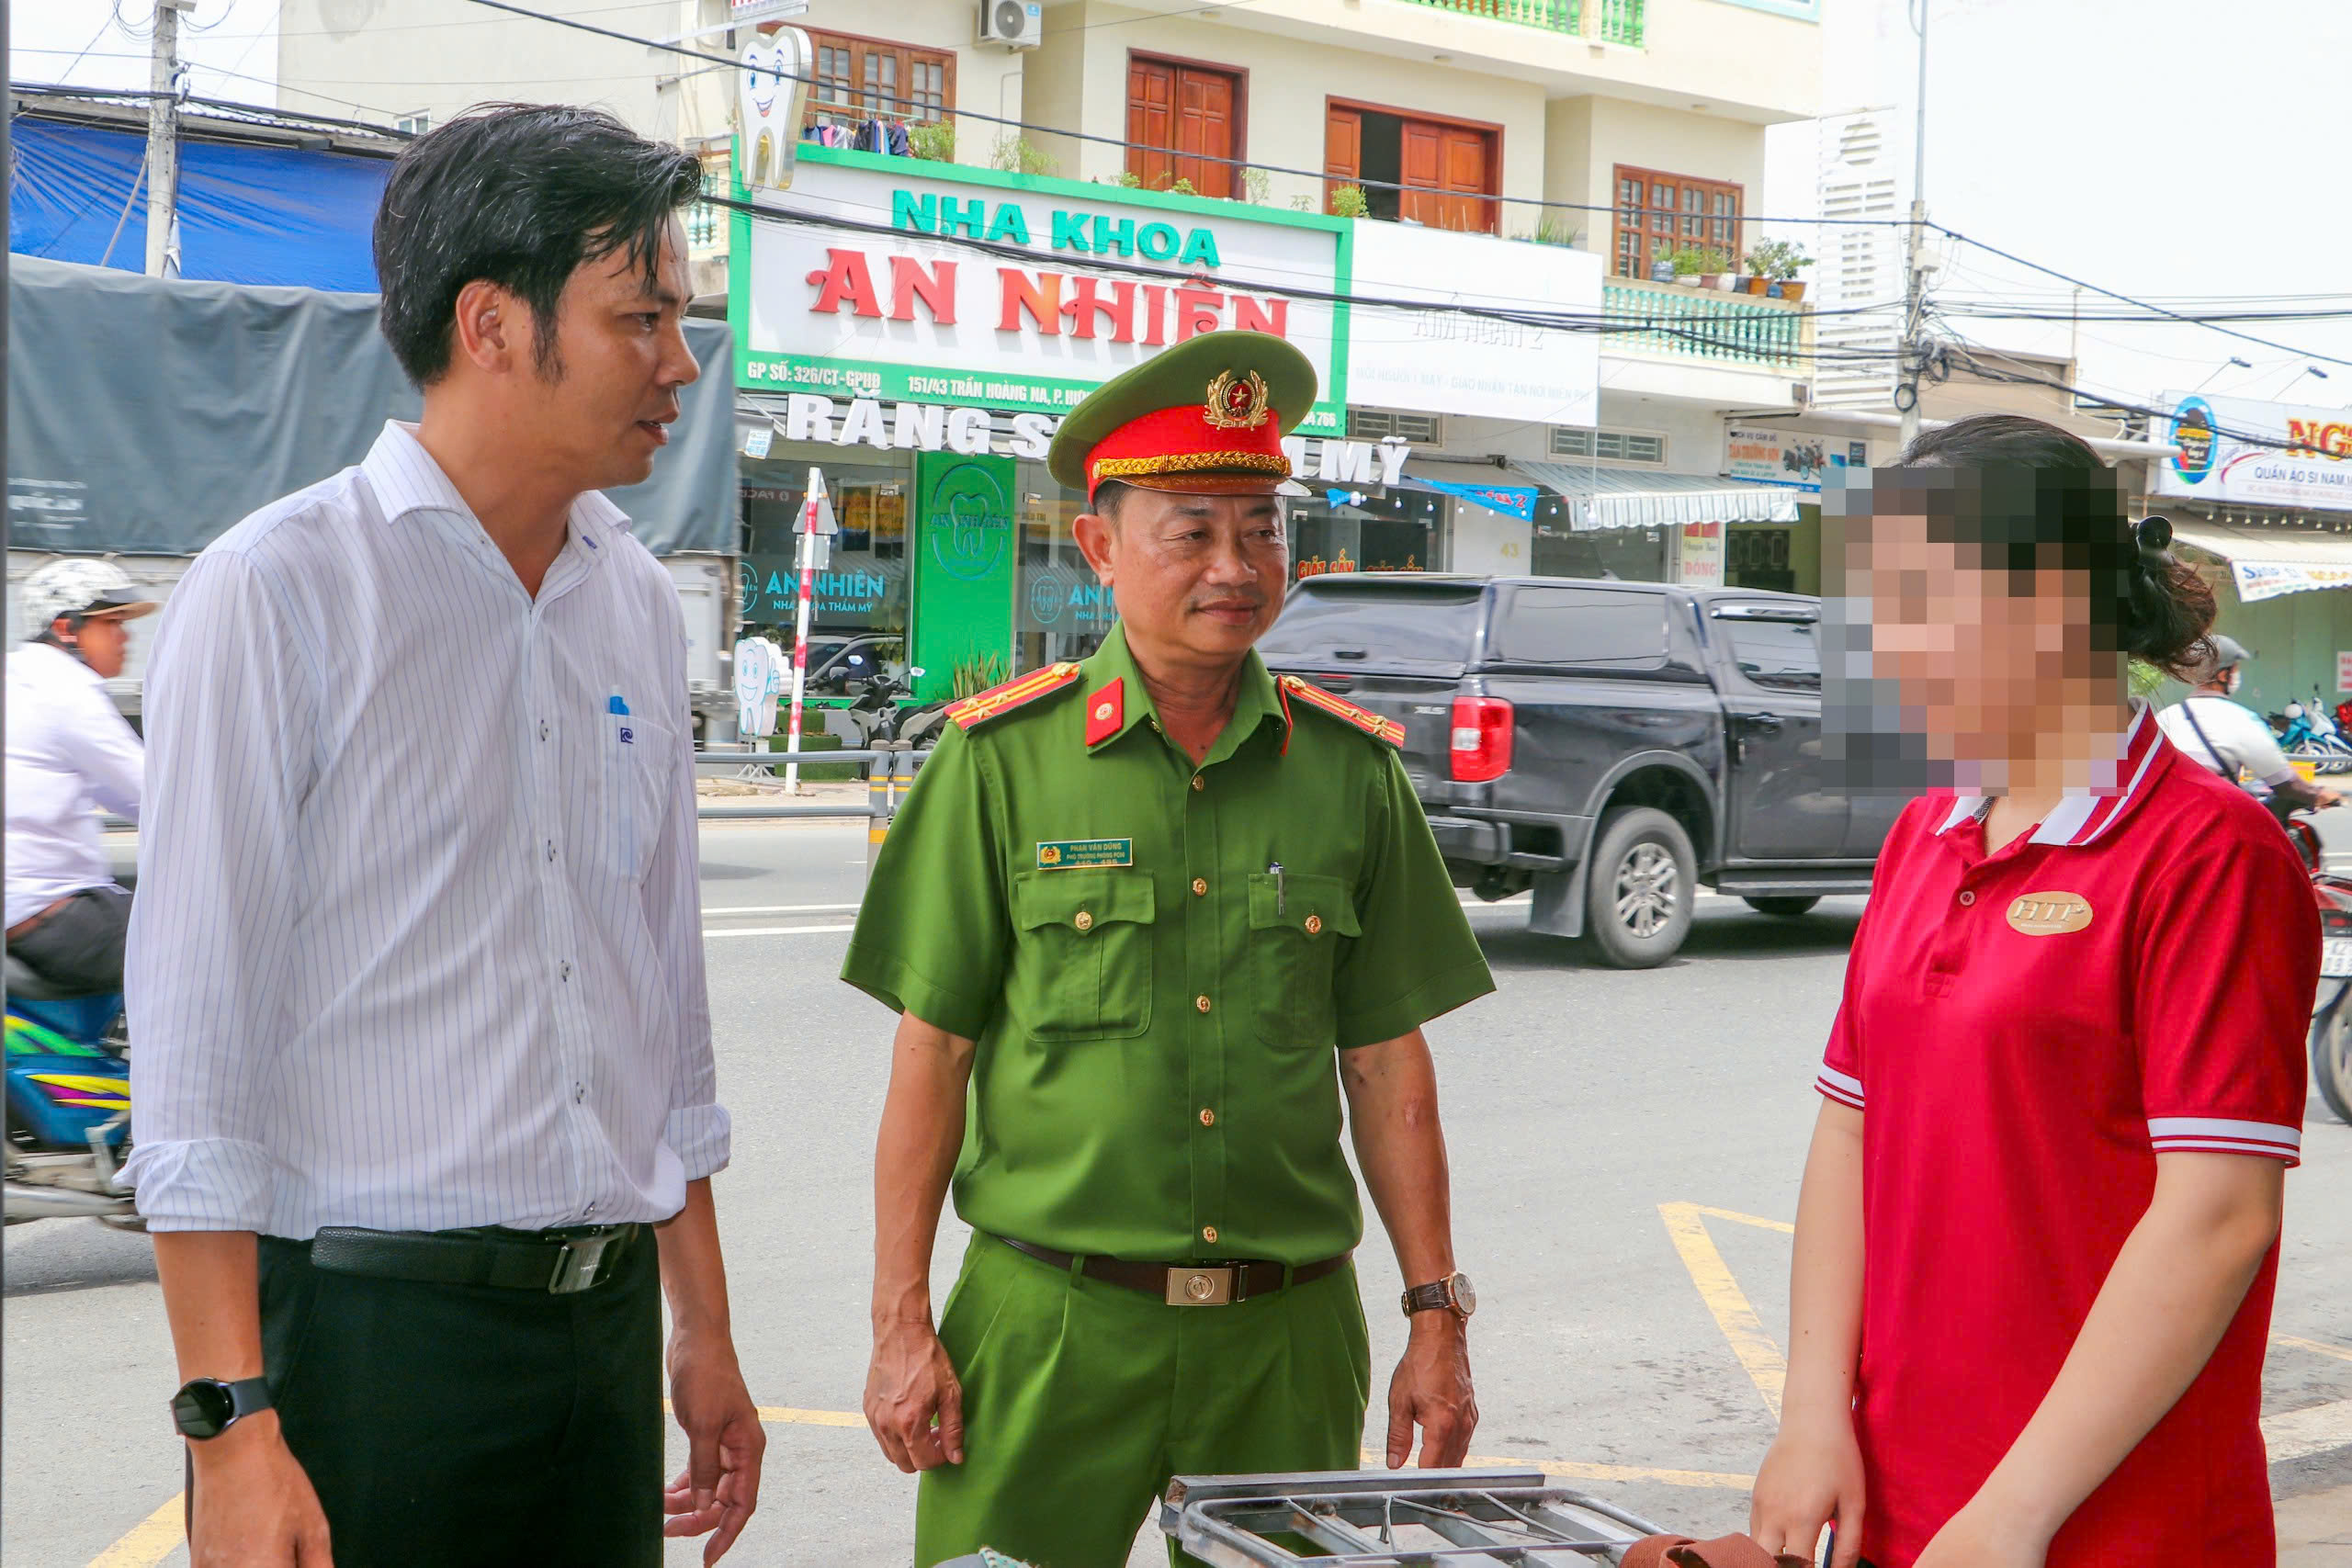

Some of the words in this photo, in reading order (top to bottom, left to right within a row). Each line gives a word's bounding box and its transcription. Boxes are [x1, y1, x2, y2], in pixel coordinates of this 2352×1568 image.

[892, 189, 1031, 244] NHA
[1051, 210, 1221, 267] KHOA
[806, 248, 958, 323] AN
[994, 267, 1289, 345] NHIÊN
[748, 360, 766, 379] GP
[770, 359, 793, 381] SỐ:
[908, 376, 948, 395] 151/43
[986, 380, 1027, 402] HOÀNG
[1030, 387, 1050, 406] NA,
[1053, 388, 1064, 405] P.
[786, 387, 991, 456] RĂNG
[1009, 412, 1066, 459] S
[1317, 411, 1337, 427] 766
[1319, 435, 1412, 485] MỸ
[1500, 543, 1520, 559] 43
[764, 570, 800, 595] AN
[811, 569, 884, 598] NHIÊN
[1069, 844, 1087, 852] PHAN
